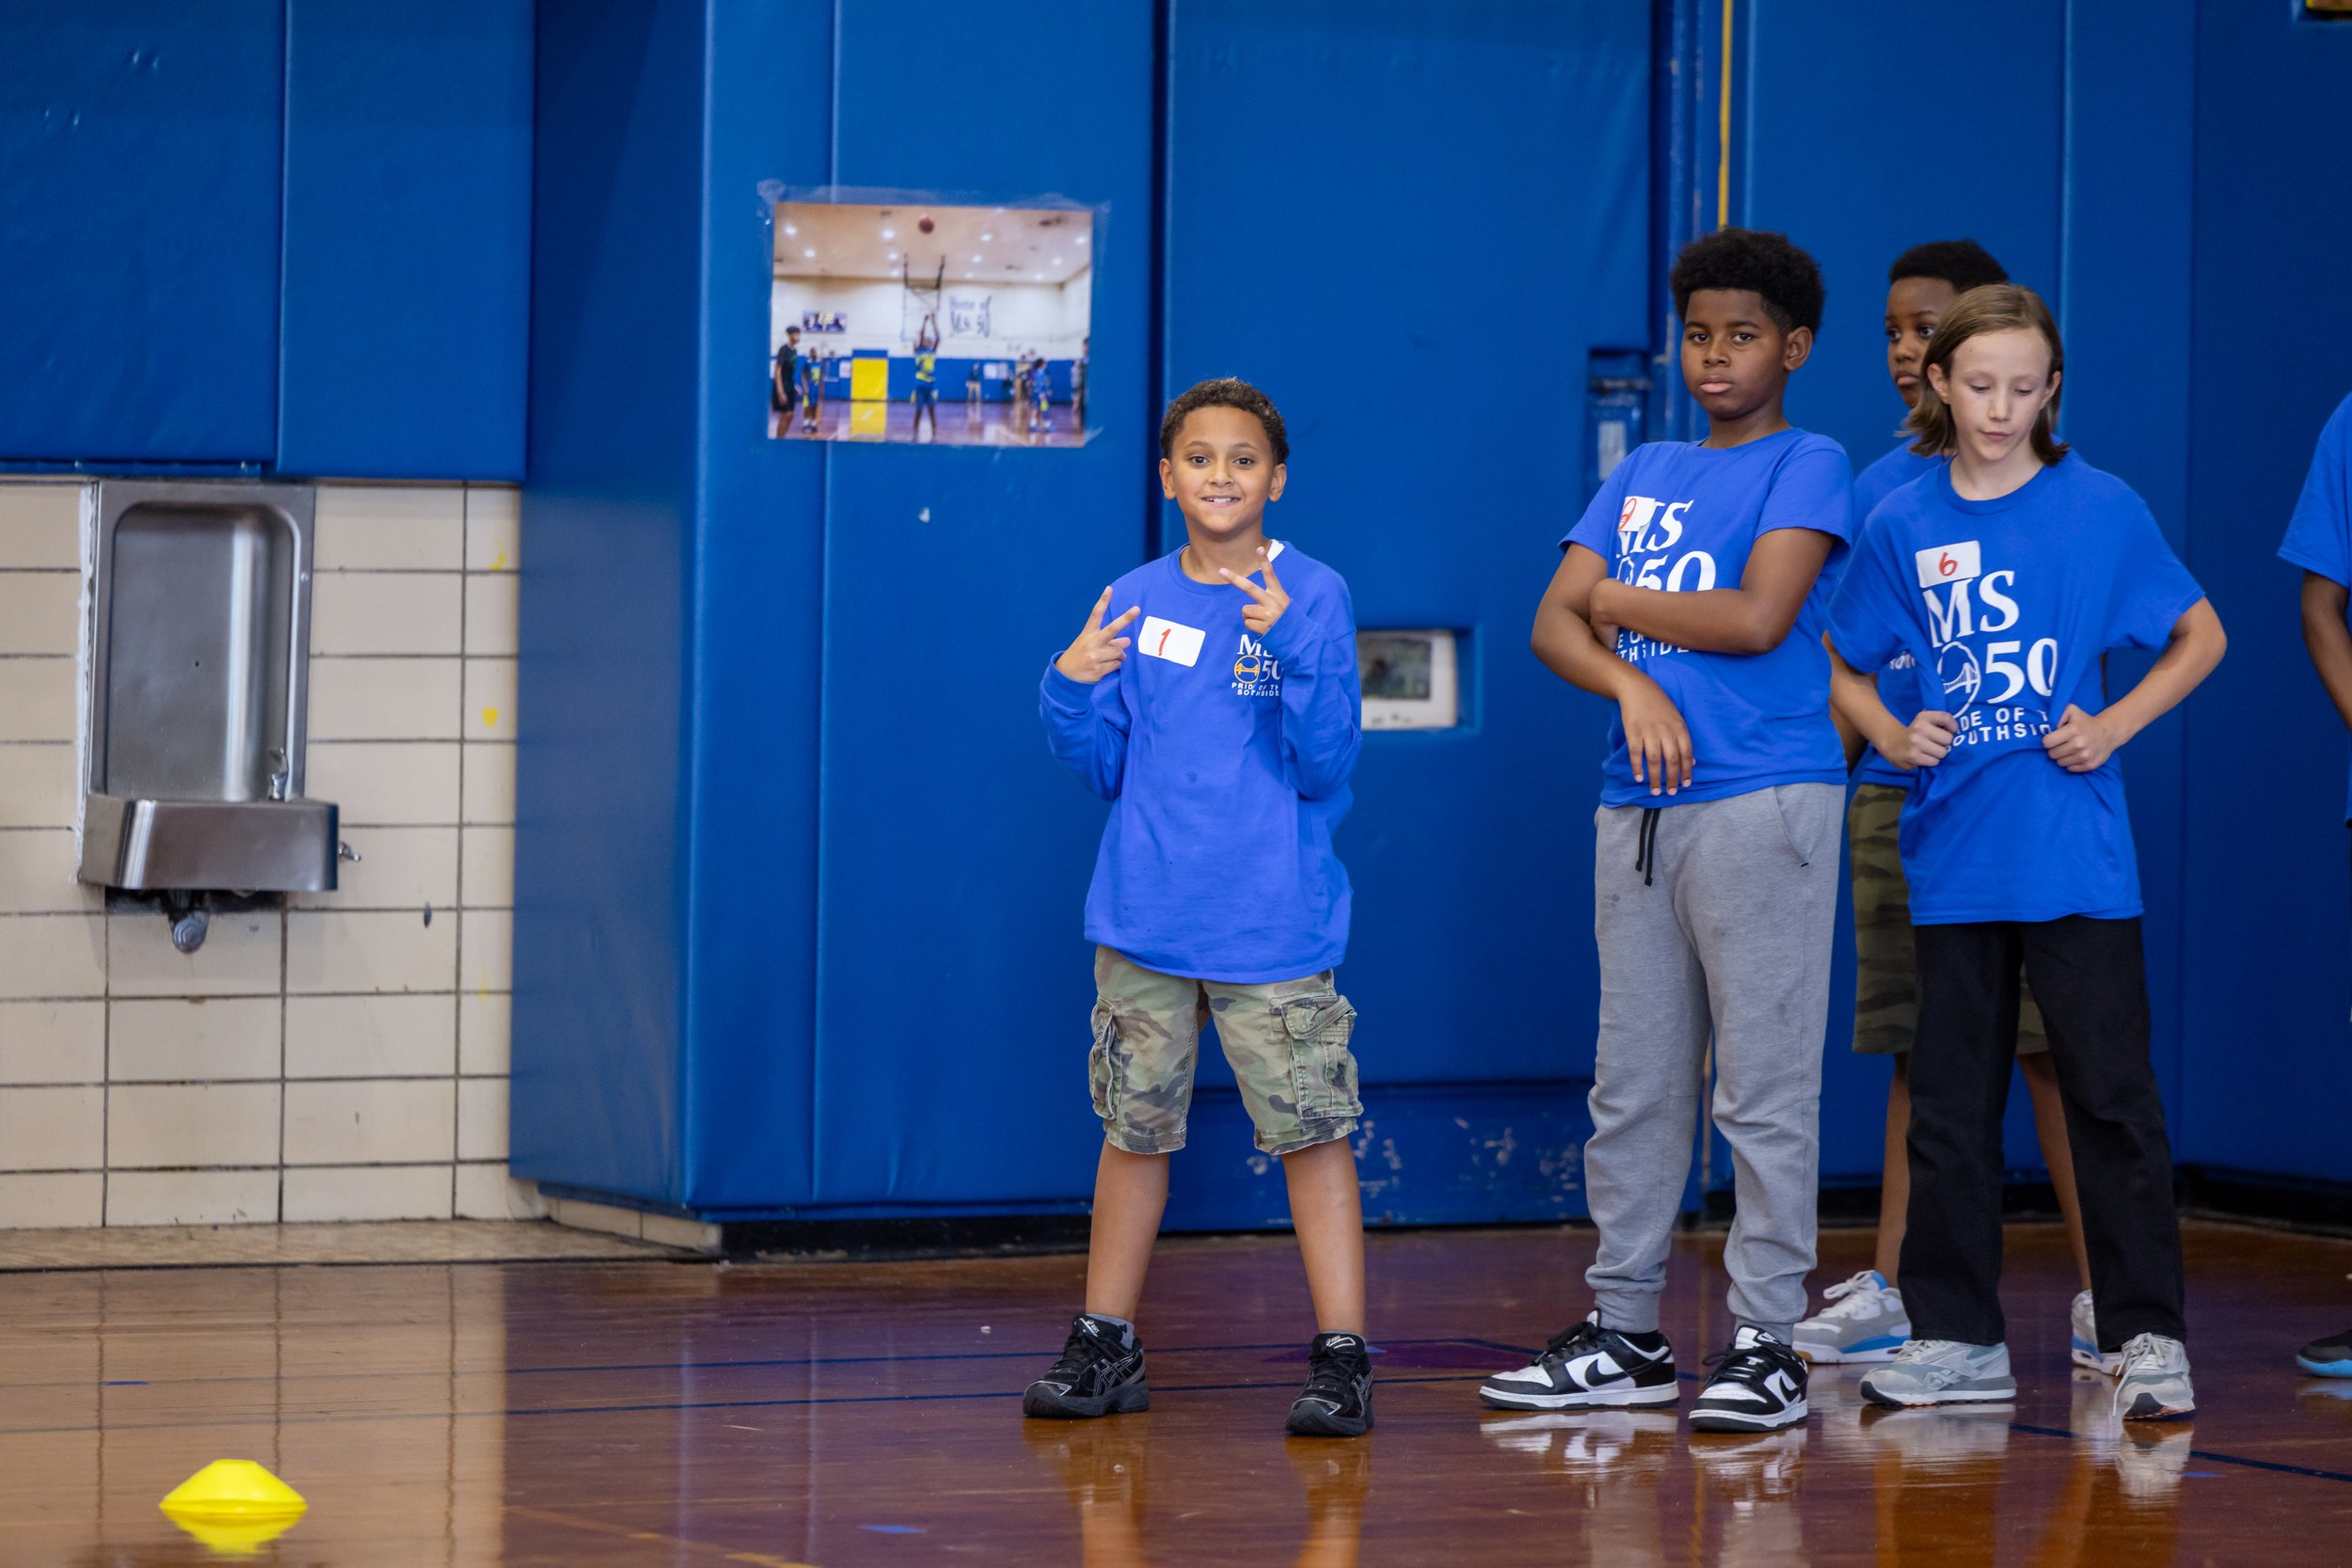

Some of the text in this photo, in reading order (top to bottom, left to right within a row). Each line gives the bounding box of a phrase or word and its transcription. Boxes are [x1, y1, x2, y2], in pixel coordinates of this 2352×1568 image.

[1938, 551, 1958, 578] 6
[1922, 570, 2021, 648] MS
[1158, 628, 1171, 657] 1
[1985, 637, 2058, 705] 50
[1994, 706, 2026, 723] OF
